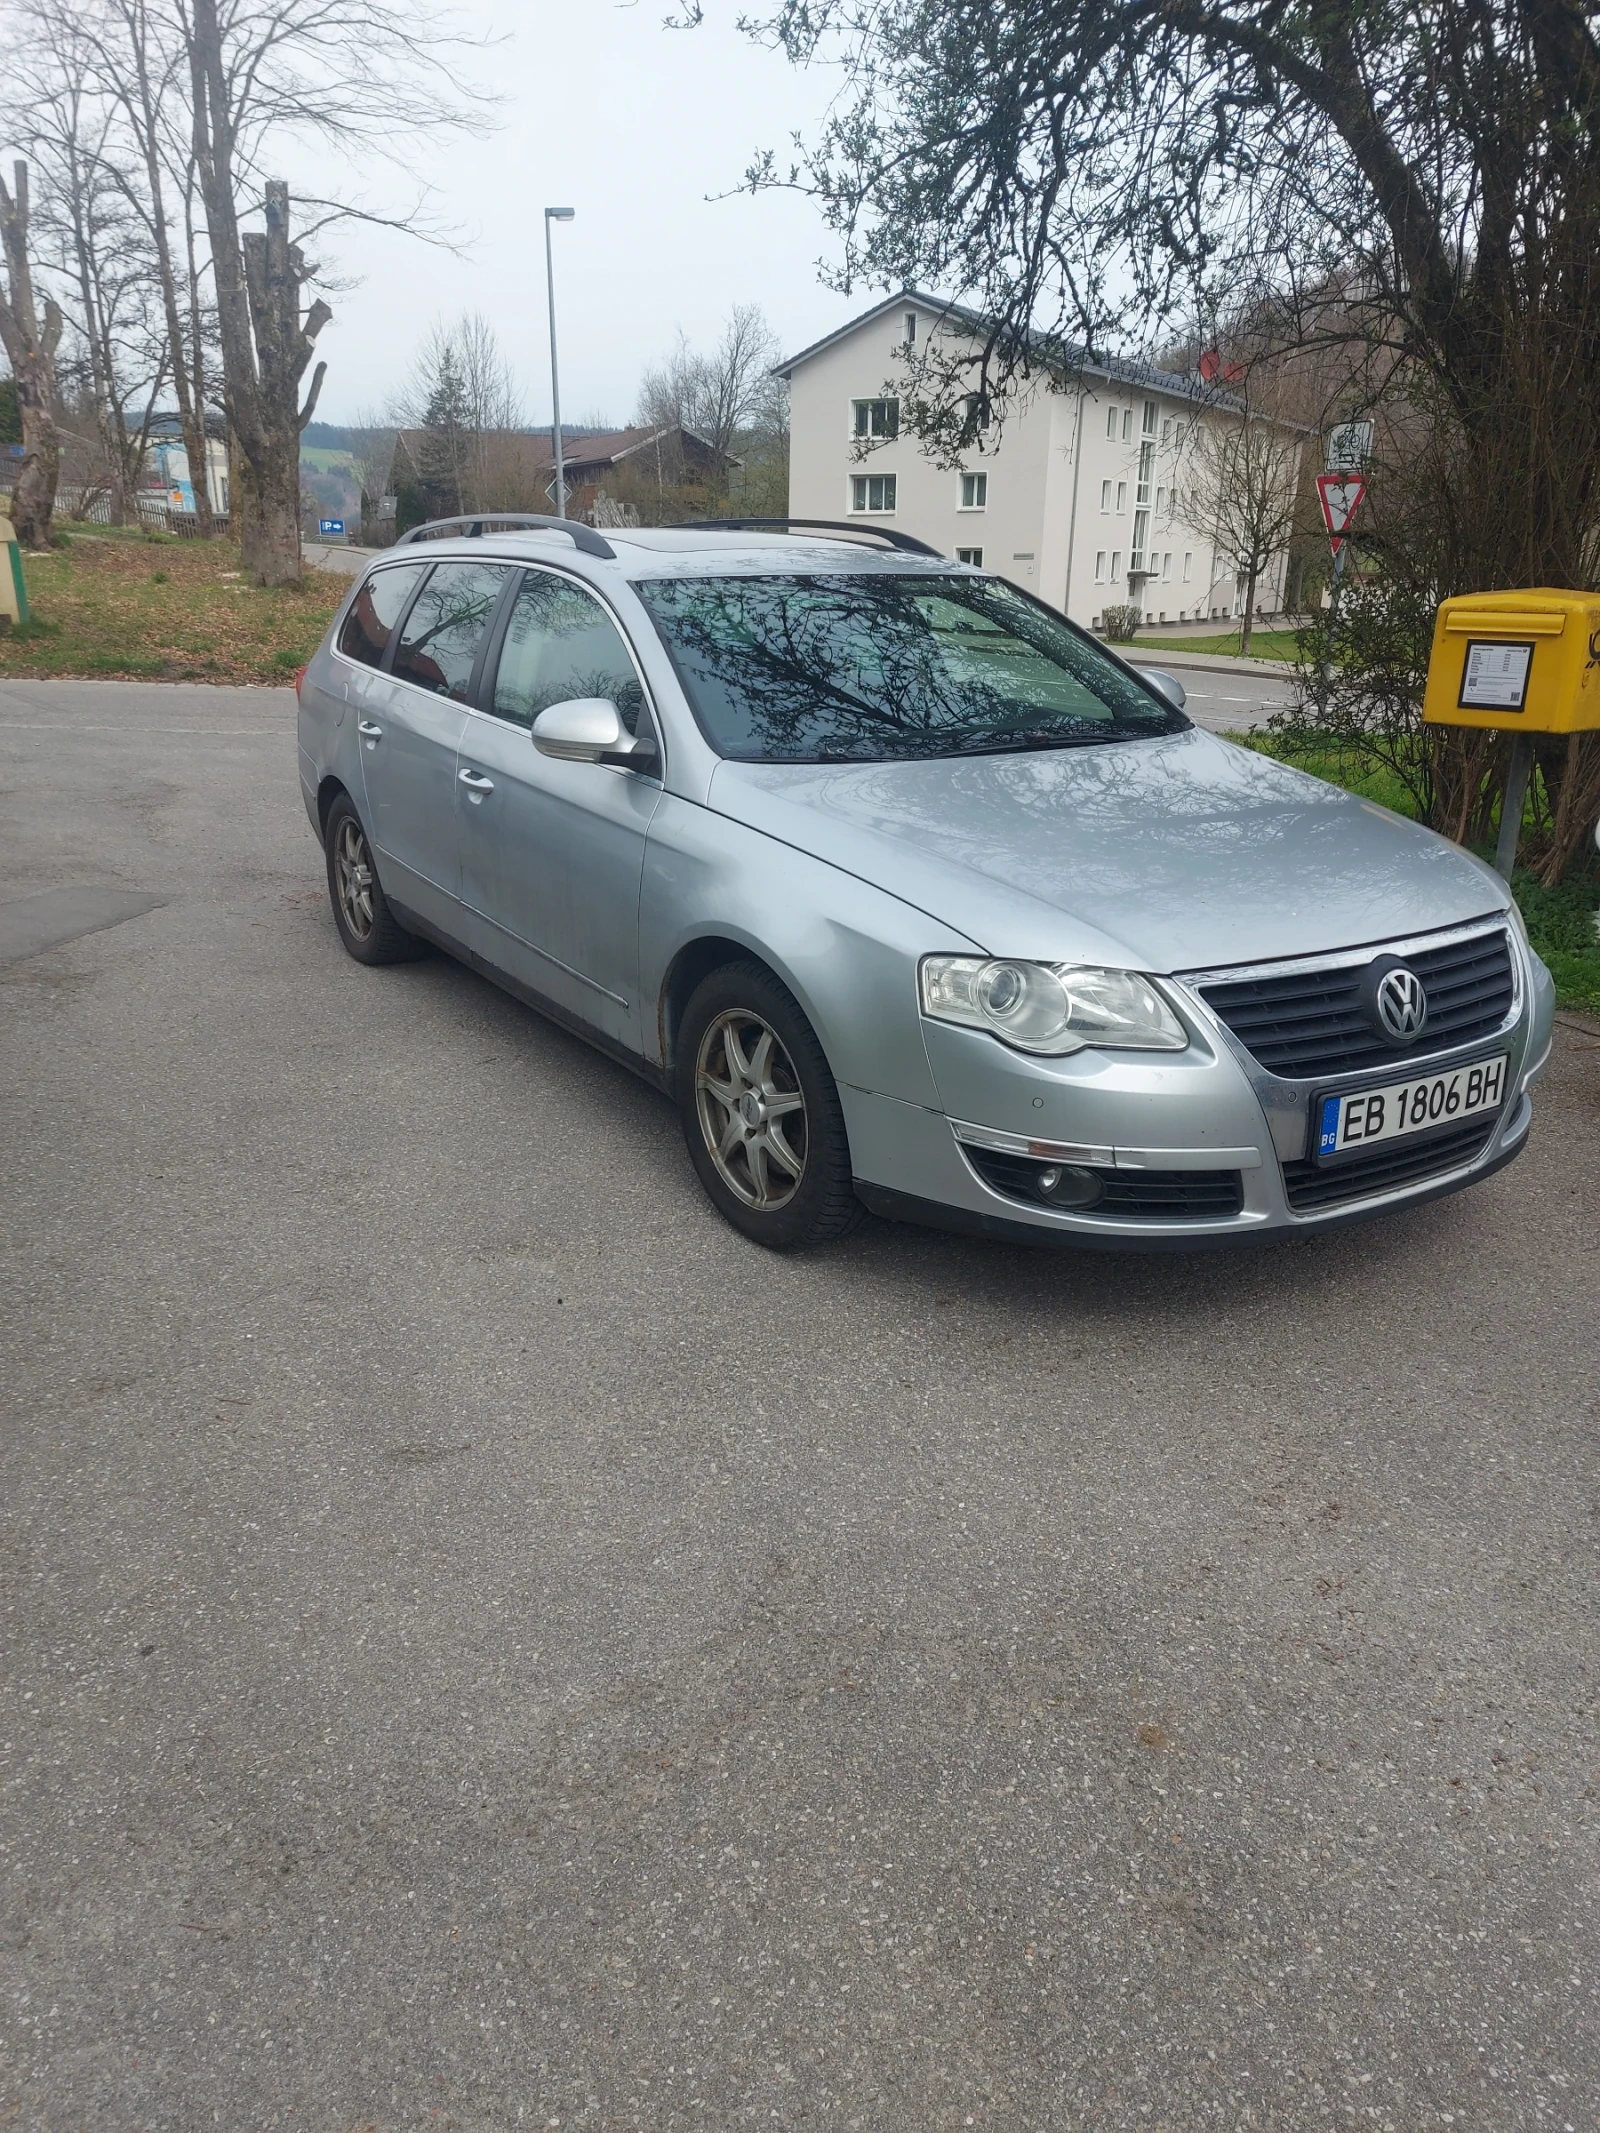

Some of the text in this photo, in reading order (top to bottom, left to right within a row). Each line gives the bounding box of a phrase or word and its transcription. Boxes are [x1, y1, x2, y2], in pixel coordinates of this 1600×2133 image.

[1378, 969, 1427, 1040] VW
[1343, 1061, 1502, 1143] EB 1806 BH
[1321, 1133, 1336, 1147] BG
